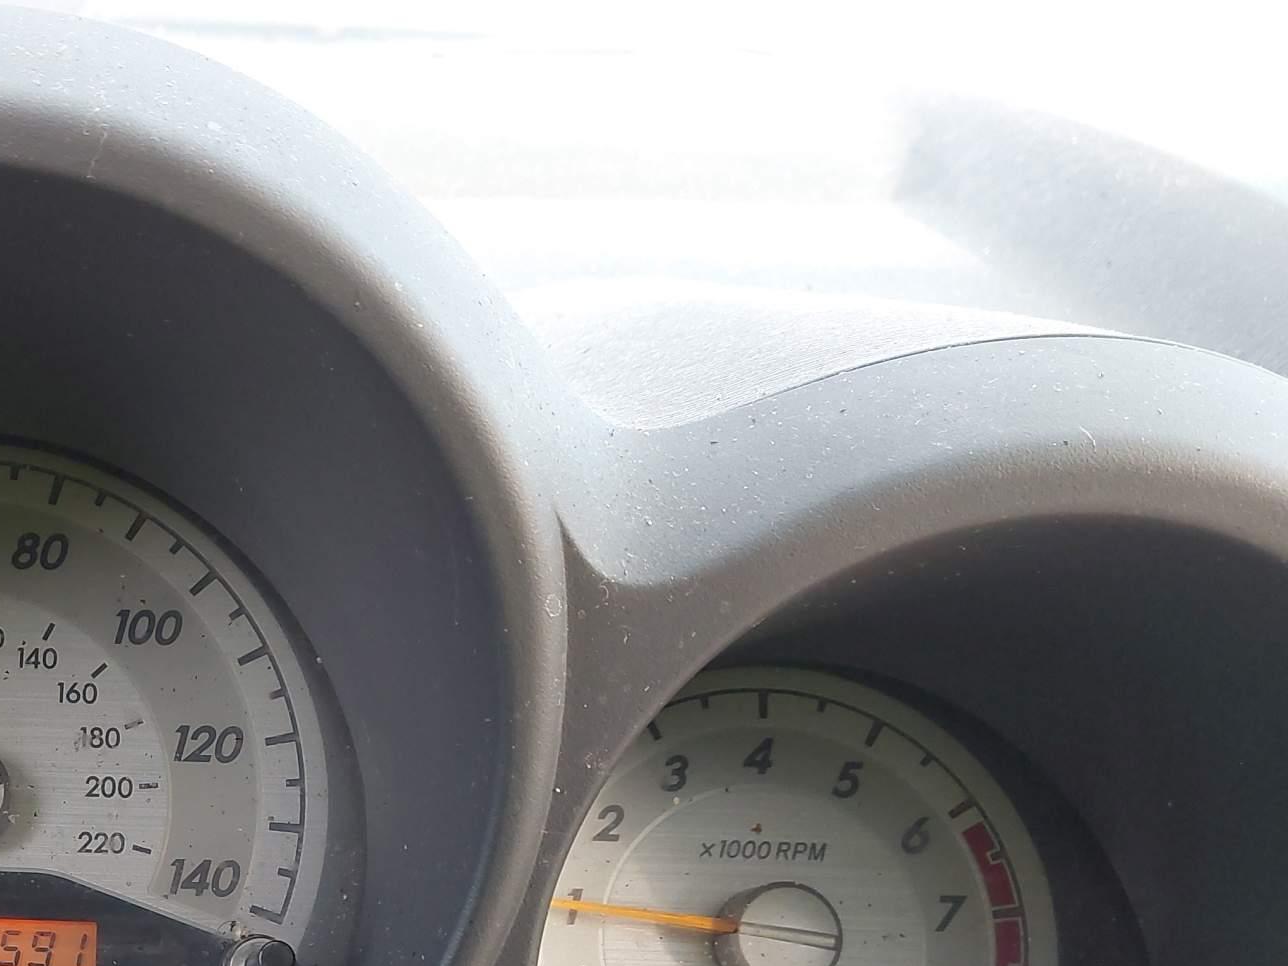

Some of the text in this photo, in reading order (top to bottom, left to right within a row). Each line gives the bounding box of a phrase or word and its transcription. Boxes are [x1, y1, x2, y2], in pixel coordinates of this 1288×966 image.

[12, 532, 69, 571] 80
[114, 609, 183, 646] 100
[17, 647, 58, 669] 140
[57, 681, 98, 704] 160
[79, 726, 121, 749] 180
[174, 725, 244, 764] 120
[743, 737, 774, 775] 4
[85, 775, 133, 798] 200
[662, 754, 689, 792] 3
[831, 761, 863, 798] 5
[592, 804, 625, 842] 2
[901, 817, 930, 855] 6
[77, 831, 126, 854] 220
[775, 841, 828, 863] RPM
[169, 859, 241, 898] 140
[566, 888, 584, 925] 1
[935, 895, 968, 932] 7
